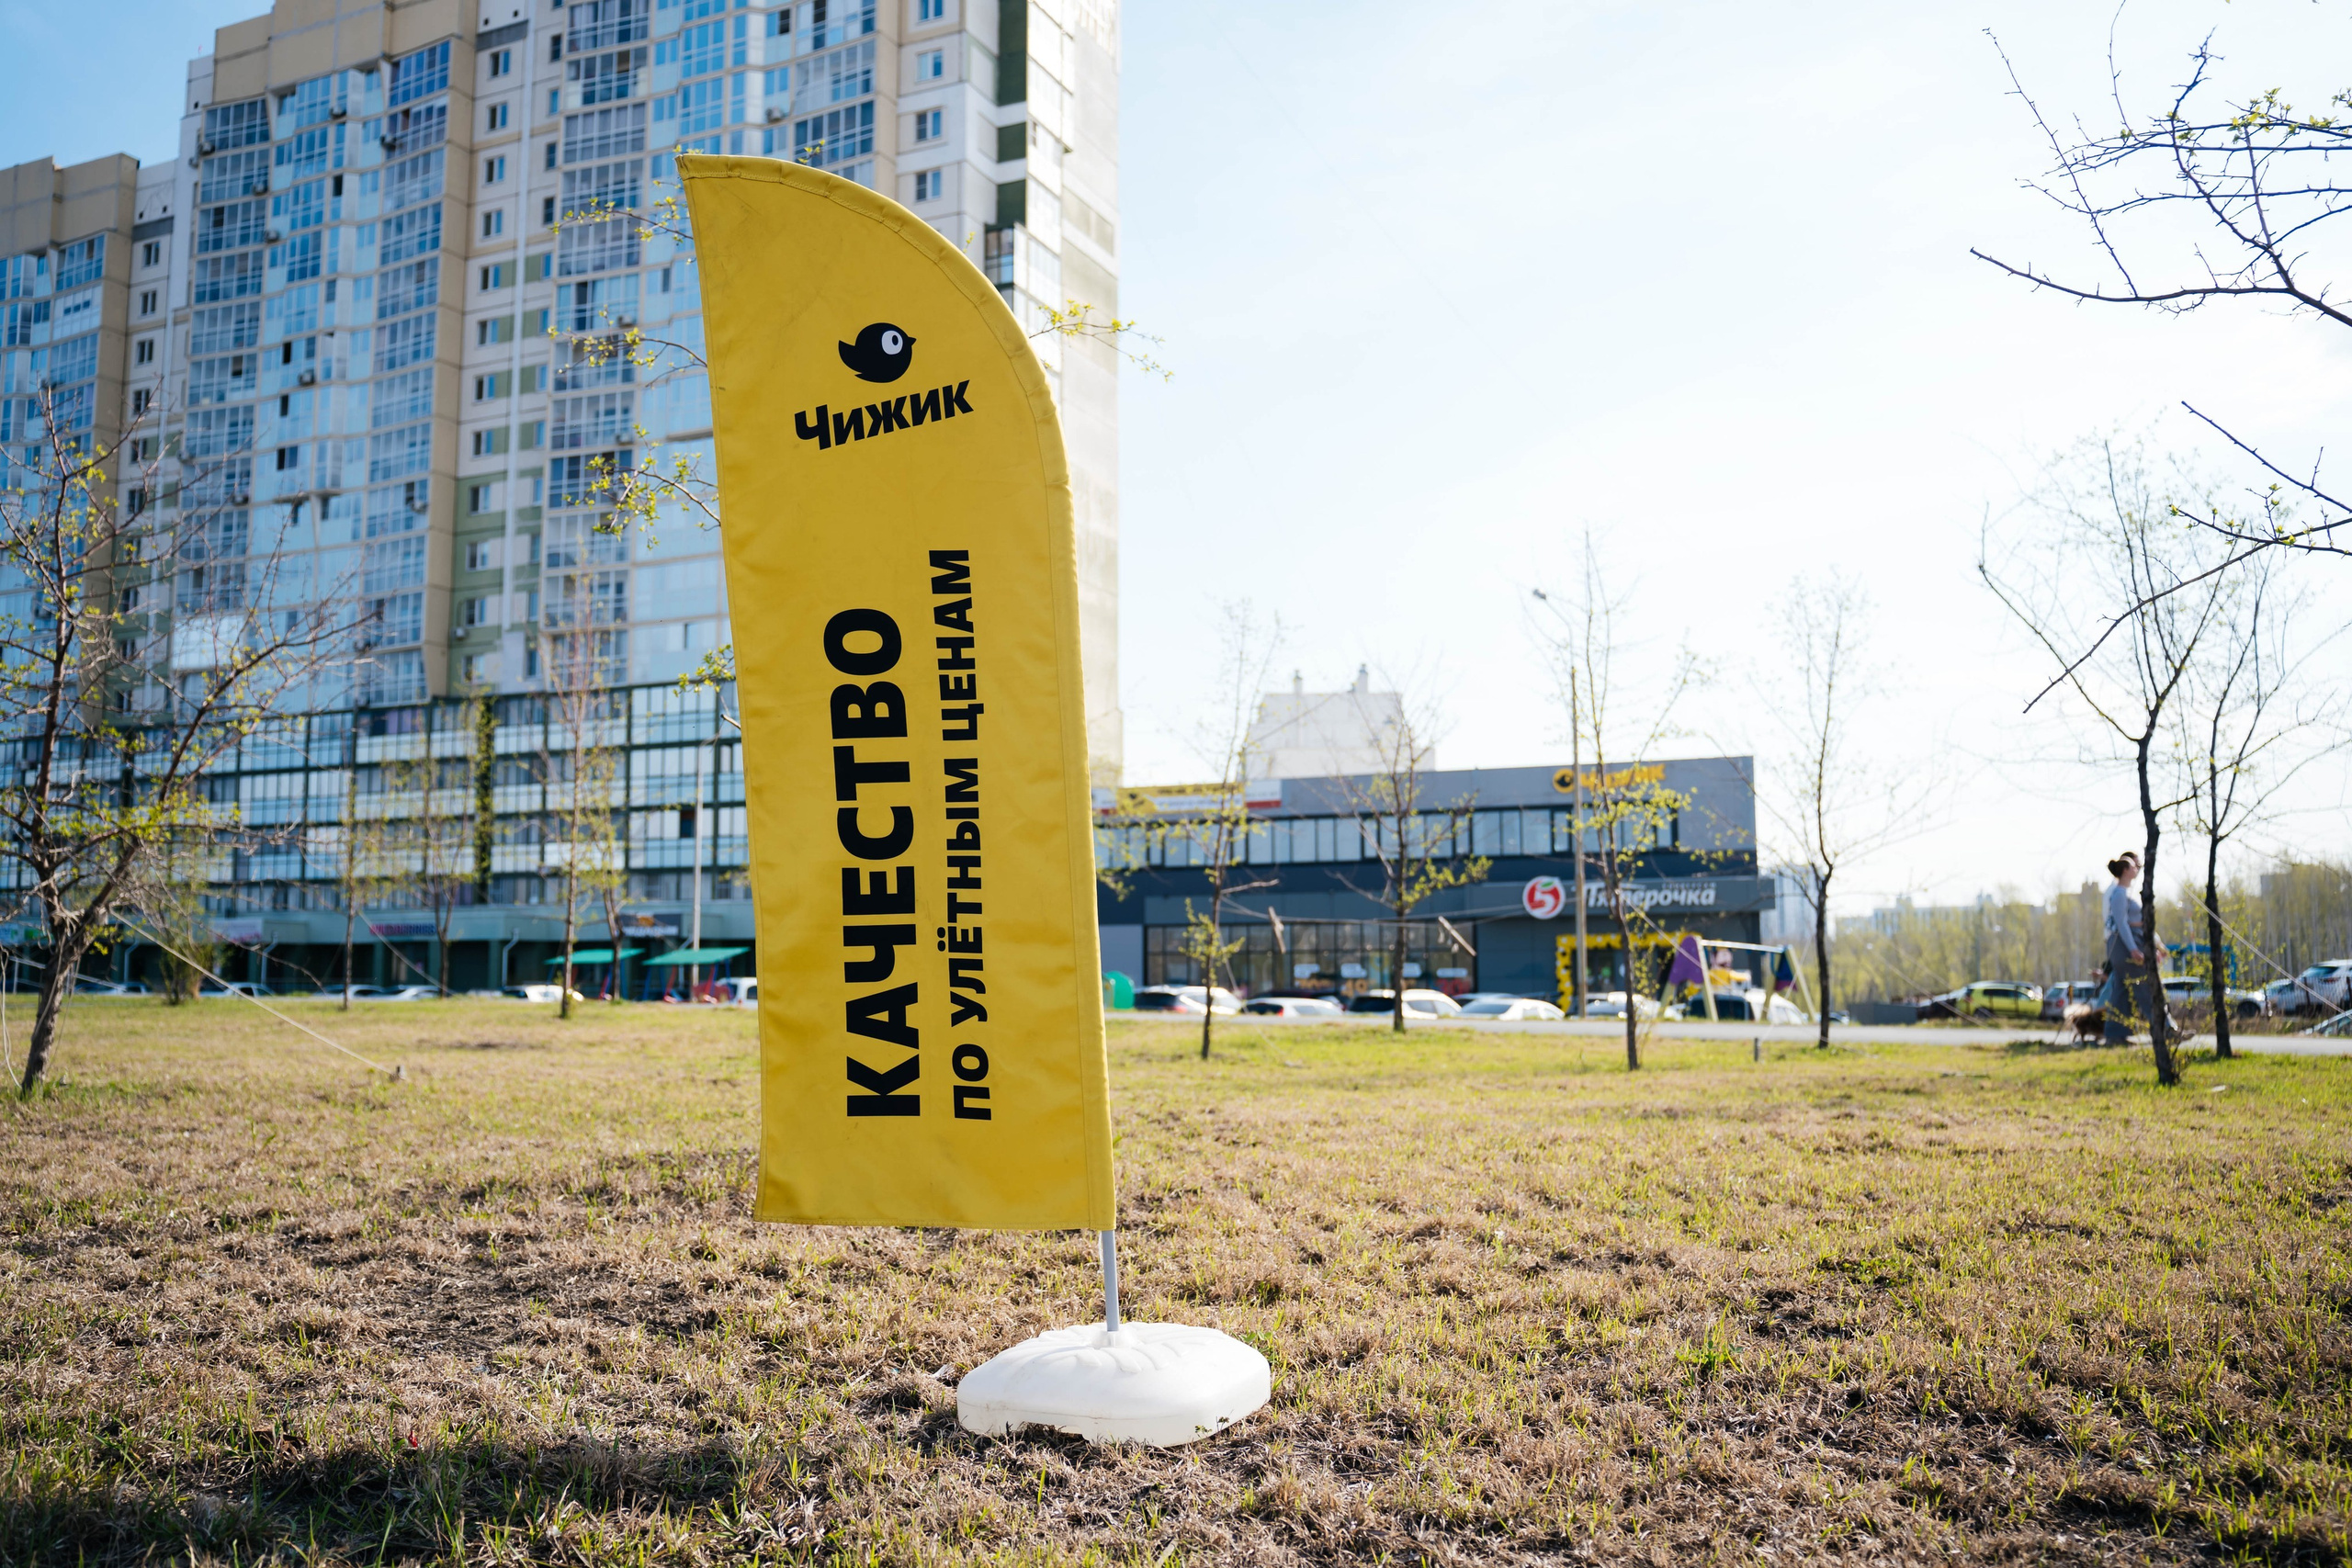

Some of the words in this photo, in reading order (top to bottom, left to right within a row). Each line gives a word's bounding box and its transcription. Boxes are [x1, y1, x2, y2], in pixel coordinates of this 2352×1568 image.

[794, 379, 974, 450] Чижик
[928, 549, 985, 741] ЦЕНАМ
[823, 608, 921, 1117] КАЧЕСТВО
[936, 757, 989, 1028] УЛЁТНЫМ
[952, 1043, 992, 1121] ПО
